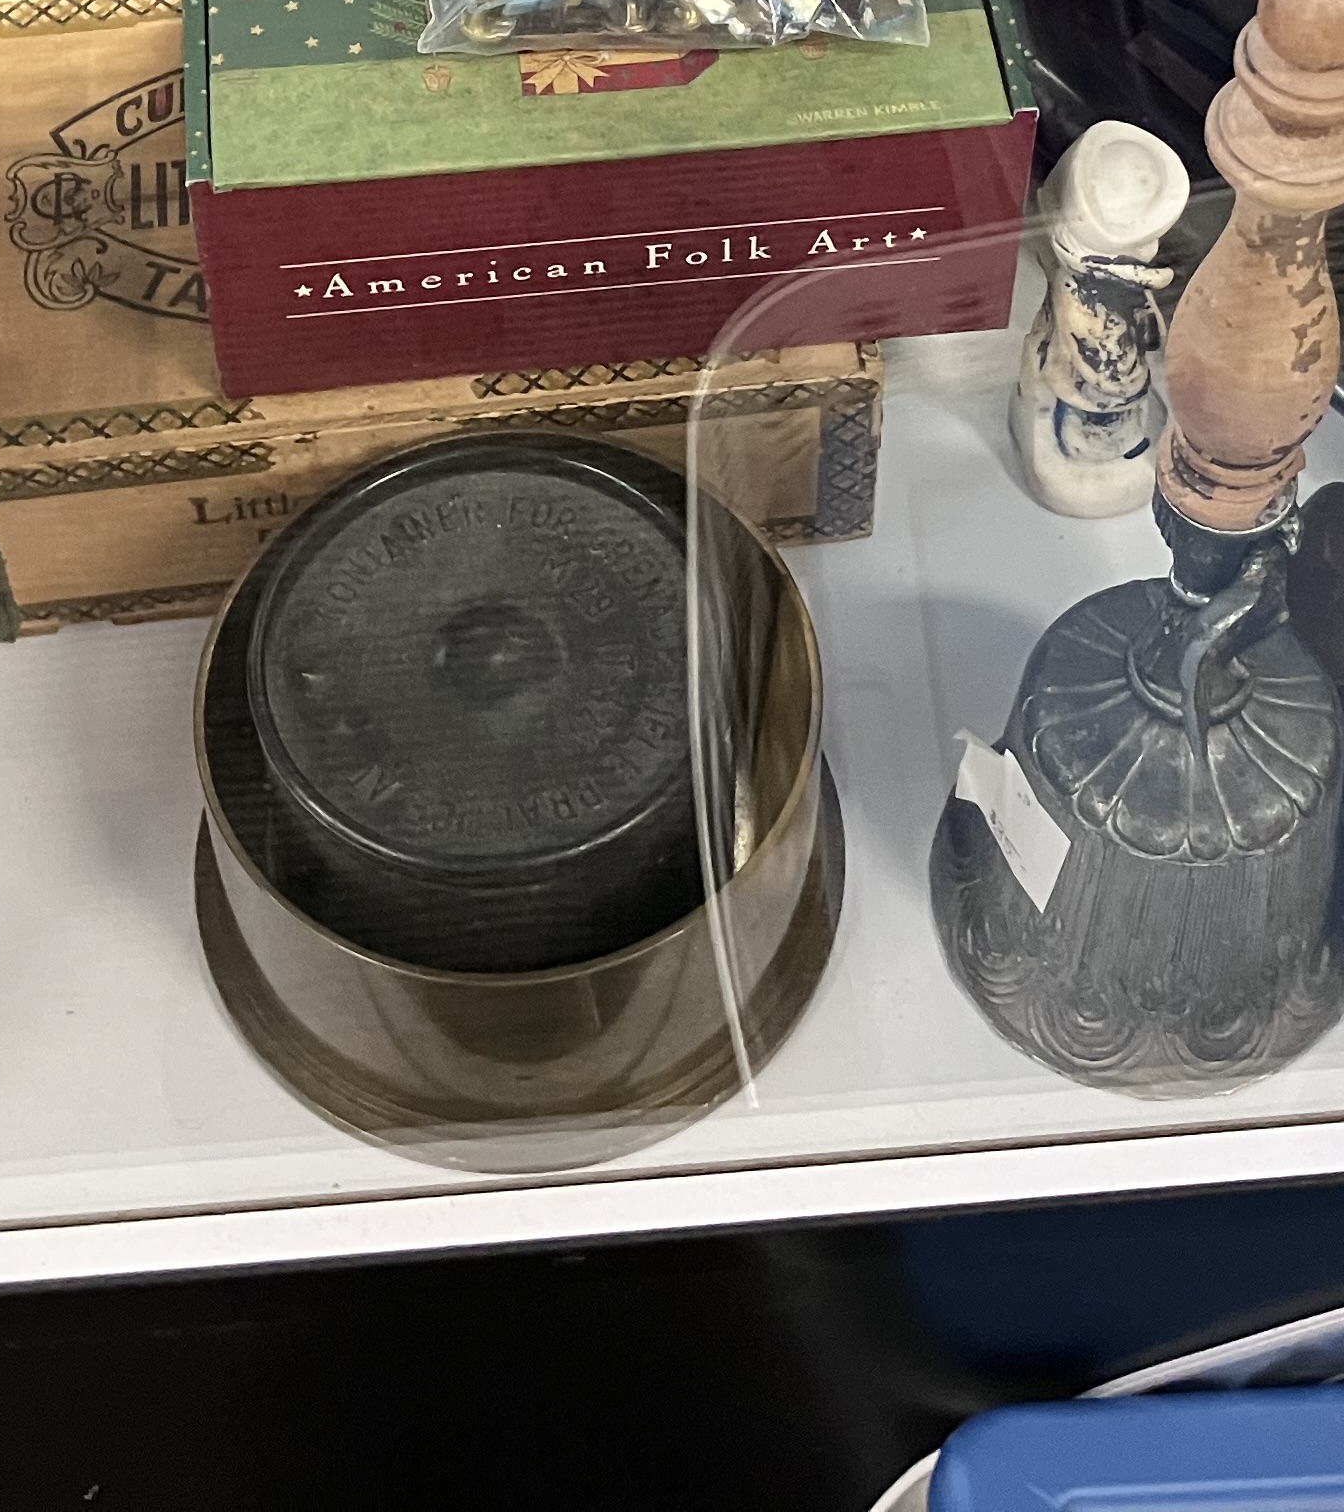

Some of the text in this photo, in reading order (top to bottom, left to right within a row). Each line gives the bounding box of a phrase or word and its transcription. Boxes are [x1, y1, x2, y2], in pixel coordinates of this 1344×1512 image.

[797, 90, 941, 126] WARREN KIMBLE
[130, 159, 191, 230] LIT
[141, 260, 209, 313] TA
[322, 227, 900, 300] American Folk Art
